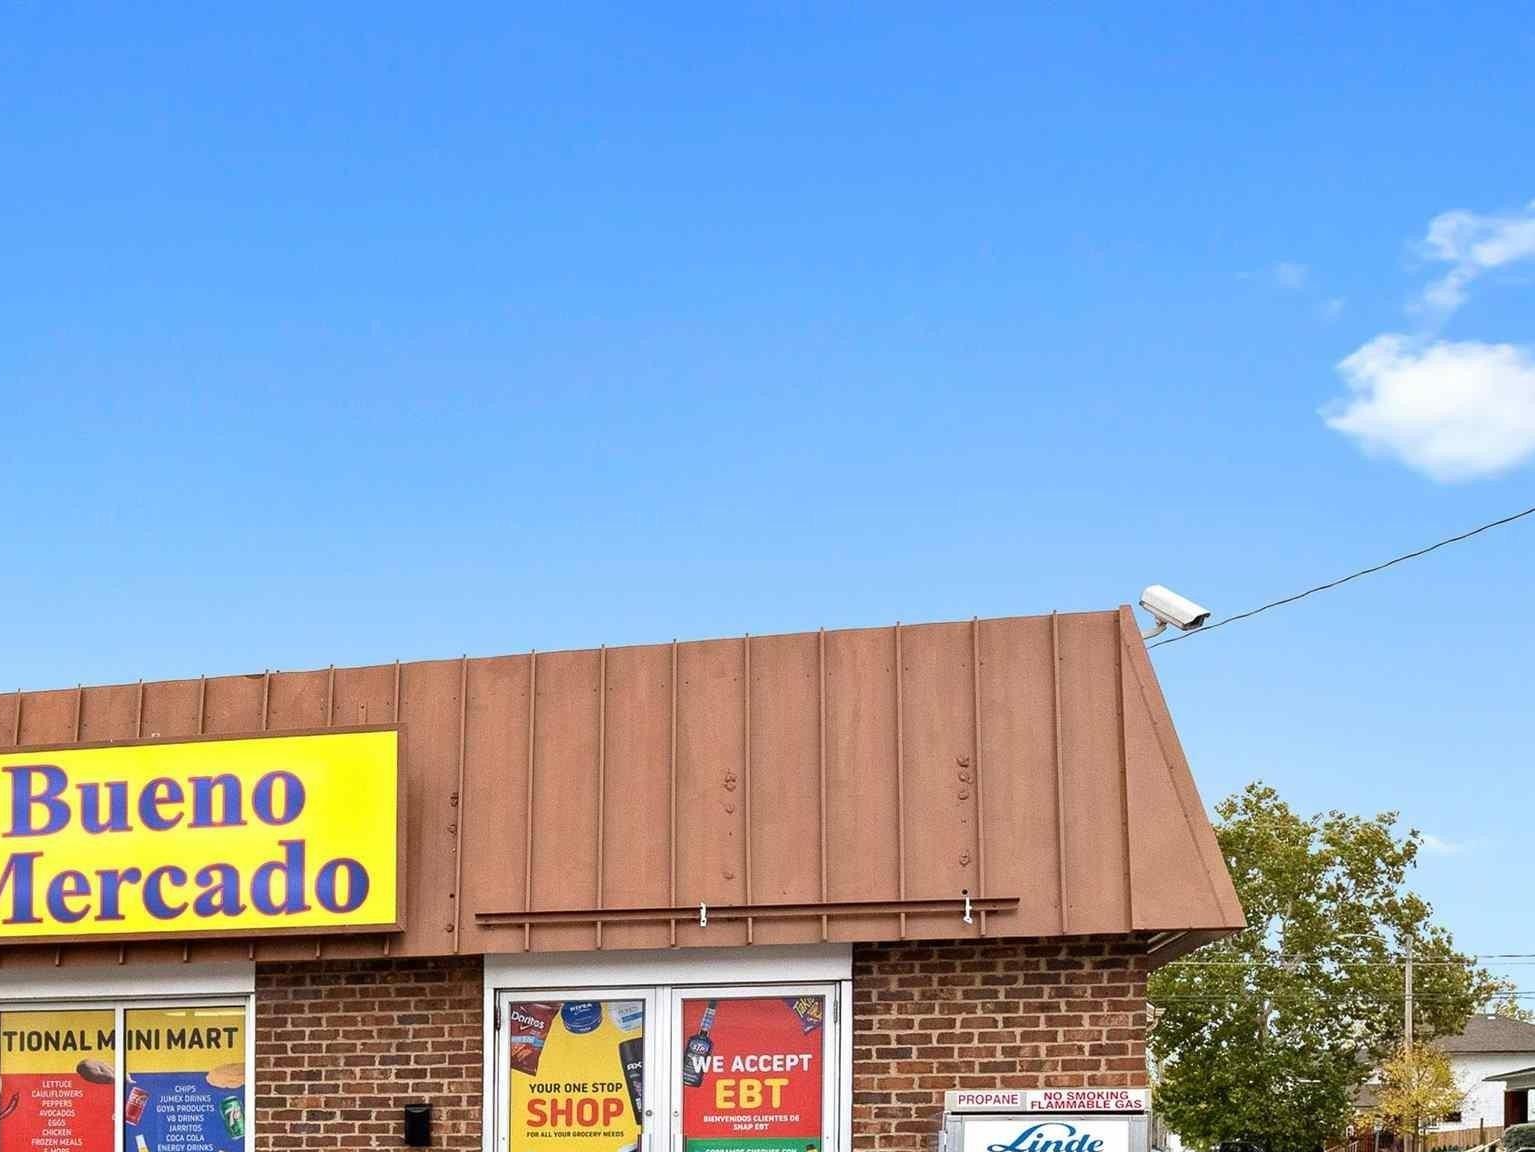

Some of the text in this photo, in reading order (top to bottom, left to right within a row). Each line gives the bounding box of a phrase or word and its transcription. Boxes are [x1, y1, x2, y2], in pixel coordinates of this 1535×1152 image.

[1, 763, 306, 838] Bueno
[511, 1011, 545, 1029] Doritos
[166, 1027, 239, 1050] MART
[692, 1056, 724, 1073] WE
[731, 1054, 813, 1072] ACCEPT
[529, 1083, 623, 1093] YOUR ONE STOP
[32, 1090, 83, 1098] CAULIFLOWERS
[715, 1078, 789, 1109] EBT
[1043, 1091, 1129, 1100] NO SMOKING
[160, 1095, 184, 1103] JUMEX
[958, 1094, 1018, 1105] PROPANE
[1031, 1100, 1142, 1110] FLAMMABLE GAS
[526, 1098, 624, 1127] SHOP
[169, 1124, 202, 1132] JARRITOS
[32, 1138, 83, 1146] FROZEN MEALS
[157, 1144, 185, 1152] ENERGY
